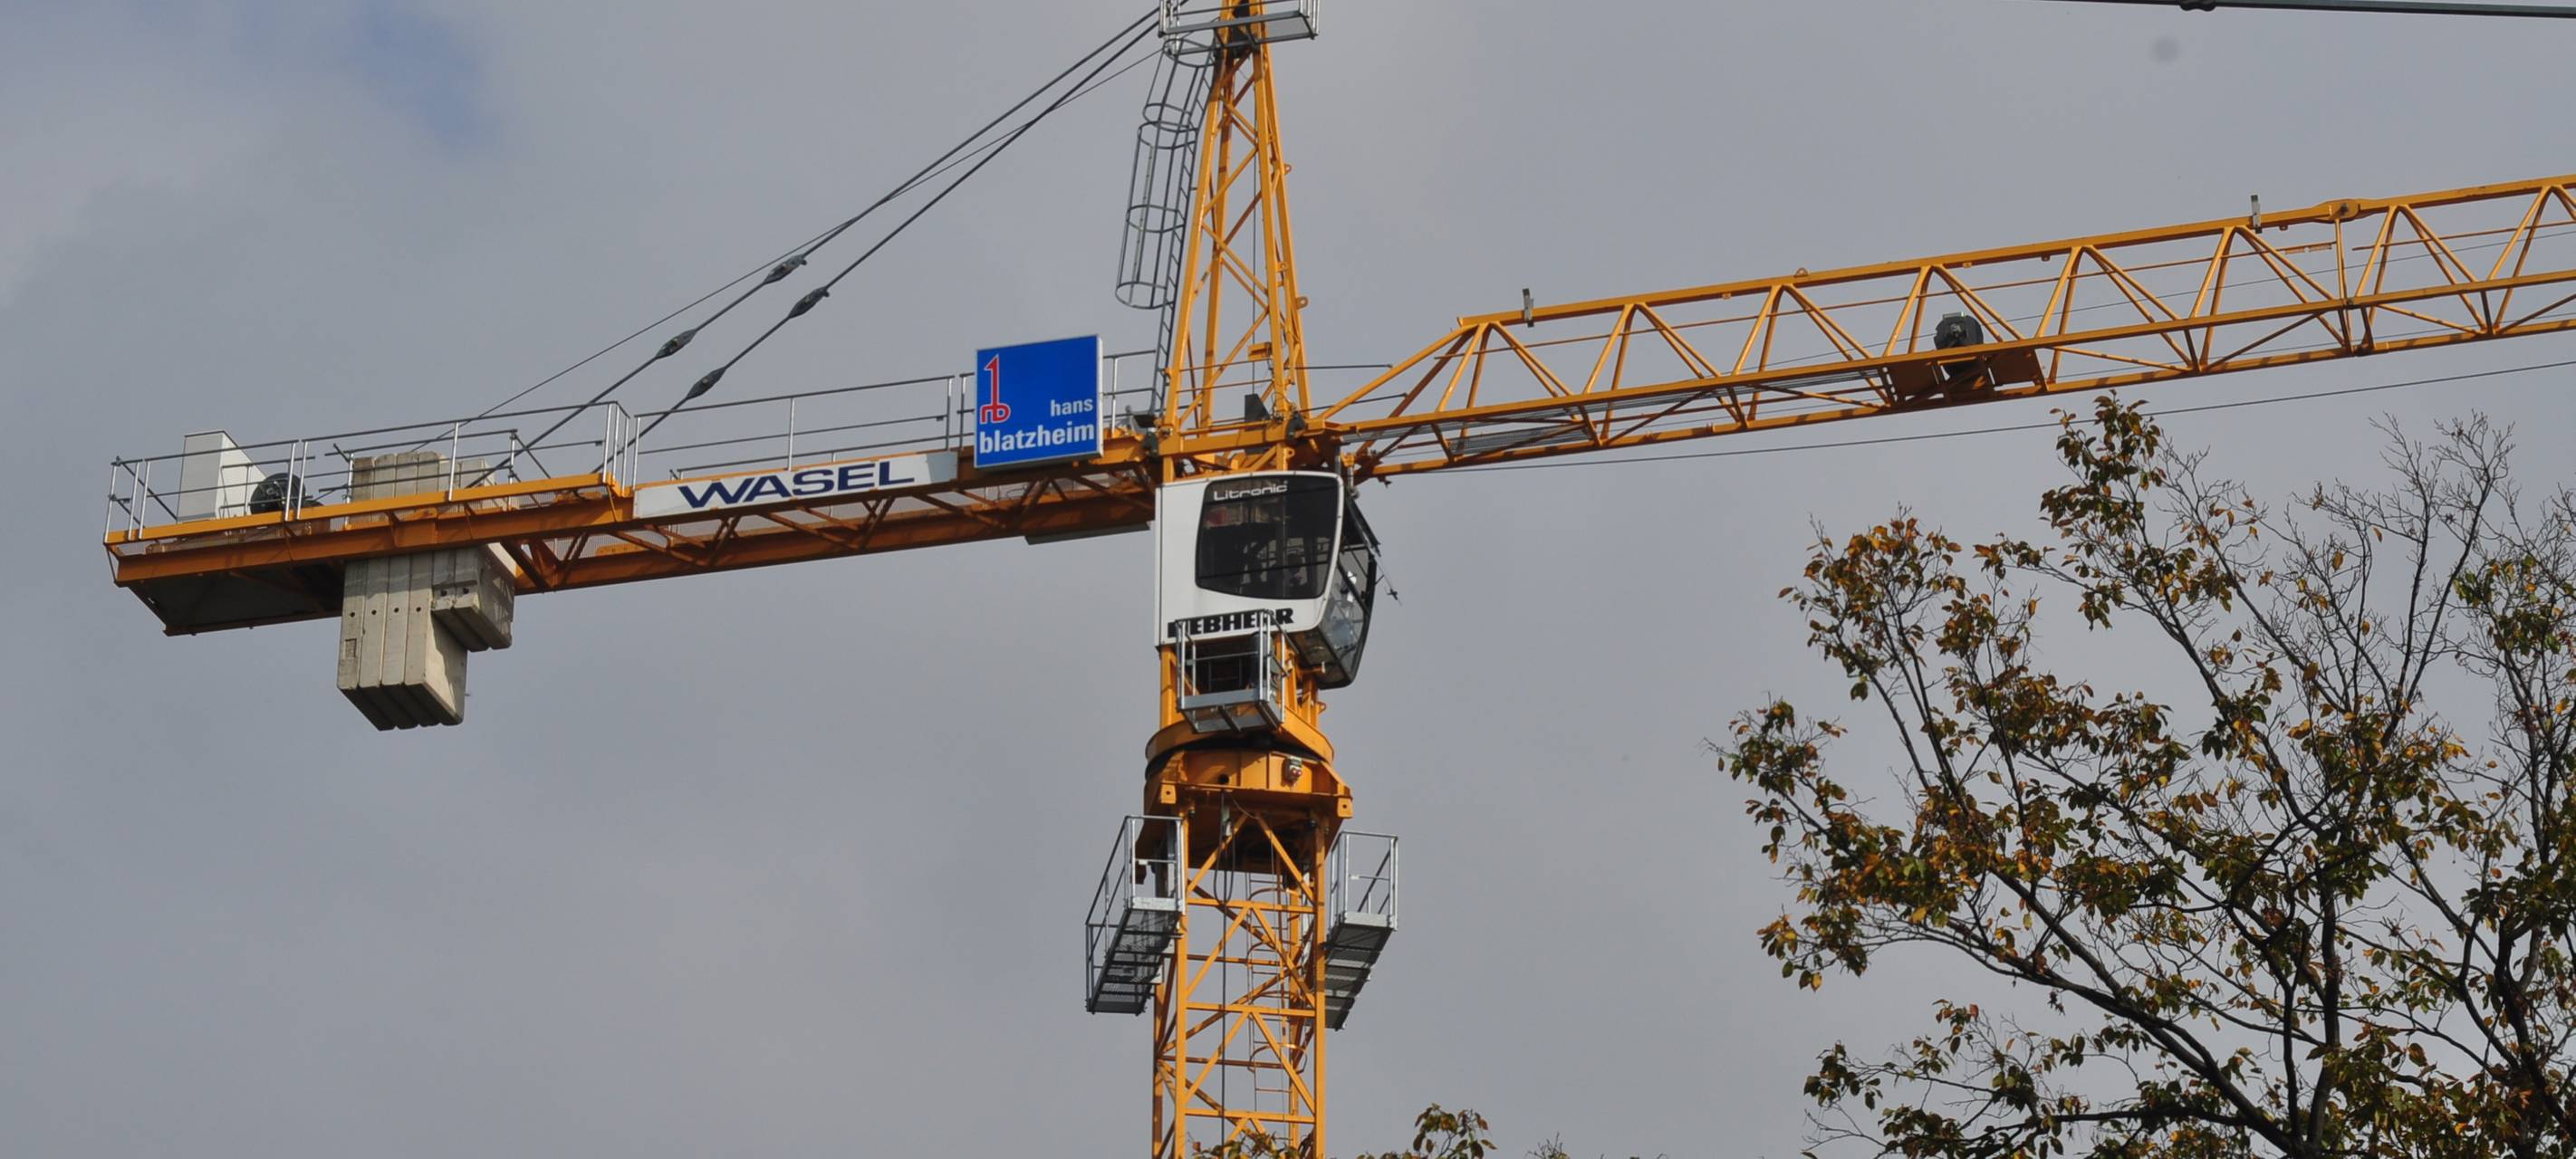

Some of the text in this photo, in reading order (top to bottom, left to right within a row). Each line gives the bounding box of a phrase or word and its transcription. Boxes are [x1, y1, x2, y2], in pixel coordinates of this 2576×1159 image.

[1050, 398, 1093, 417] hans
[979, 420, 1095, 454] blatzheim
[678, 461, 915, 509] WASEL
[1214, 484, 1288, 501] Litronic
